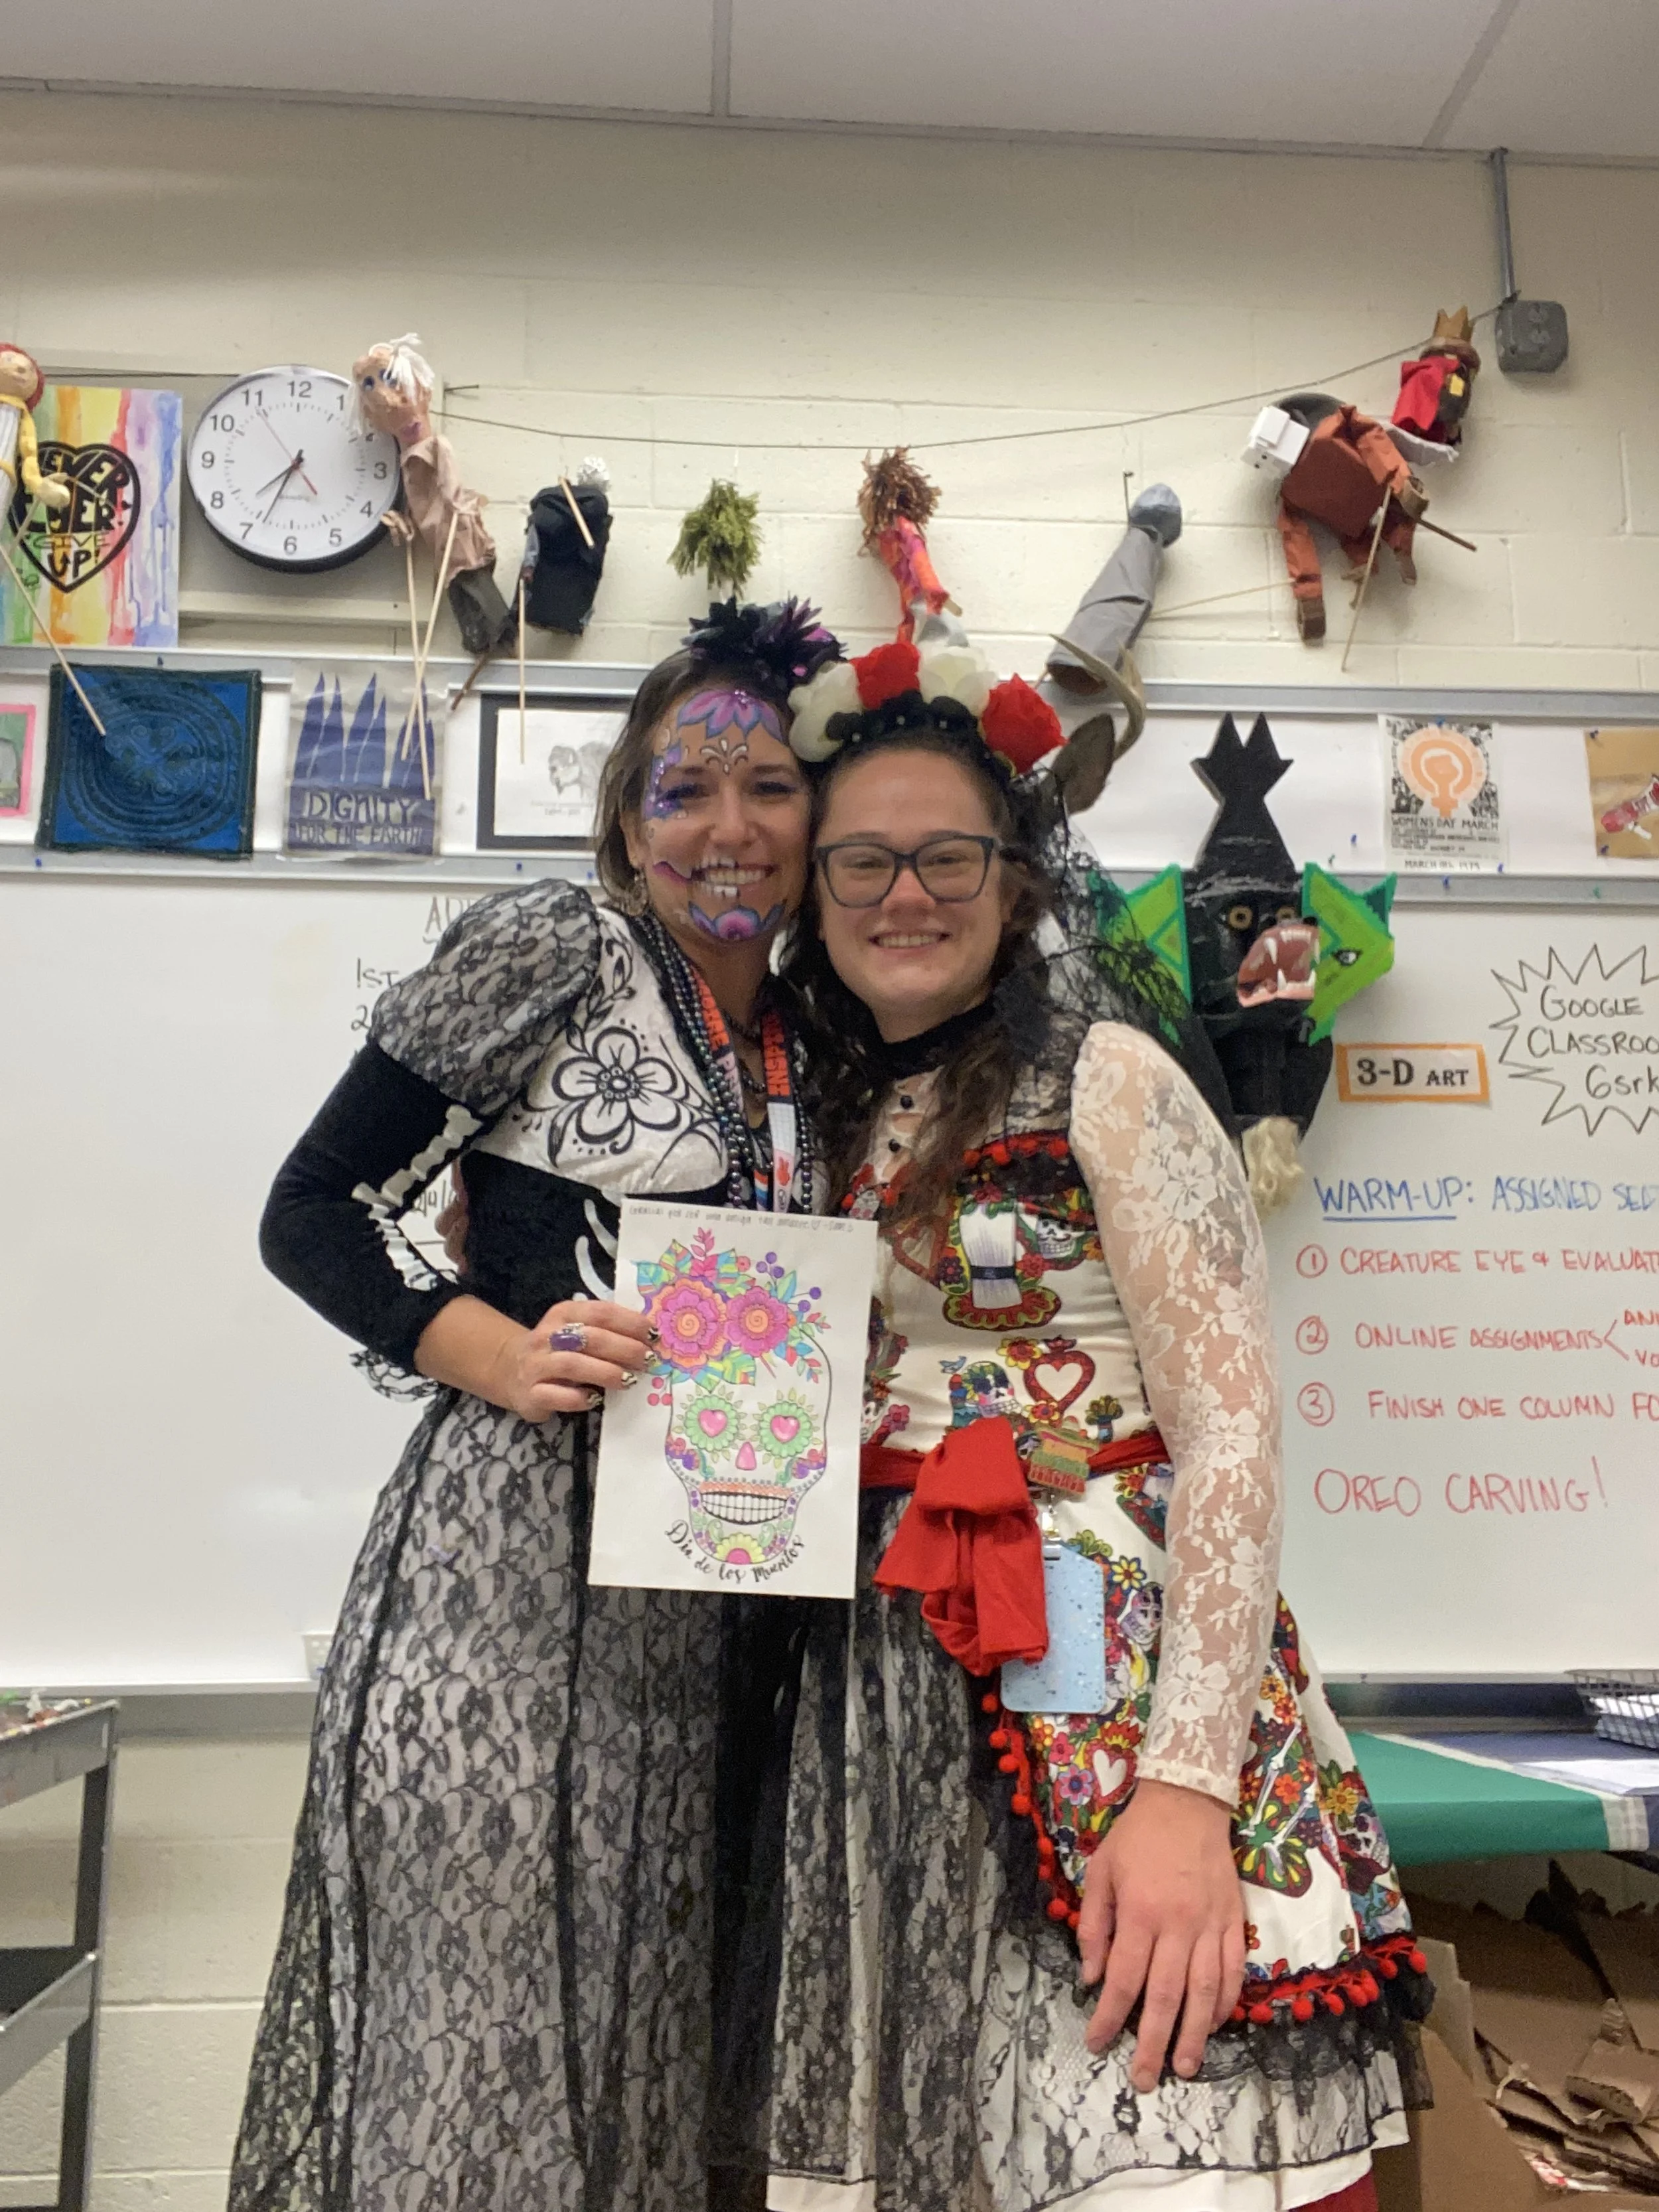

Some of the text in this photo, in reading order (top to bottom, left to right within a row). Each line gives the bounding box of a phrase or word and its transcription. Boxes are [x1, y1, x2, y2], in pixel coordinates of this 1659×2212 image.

[242, 390, 263, 406] 11
[287, 380, 312, 398] 12
[337, 394, 345, 411] 1
[210, 414, 234, 432] 10
[201, 451, 214, 469] 9
[374, 462, 387, 480] 3
[210, 491, 224, 509] 8
[360, 500, 372, 518] 4
[239, 522, 253, 540] 7
[329, 528, 342, 547] 5
[33, 534, 110, 550] GIVE
[283, 536, 297, 554] 6
[47, 548, 100, 579] UP!
[306, 792, 417, 825] DIGNITY
[1462, 819, 1499, 830] MARCH
[333, 824, 363, 845] THE
[1540, 984, 1644, 1021] GOOGLE
[1356, 1058, 1469, 1086] 3-D ART
[1313, 1176, 1473, 1215] WARM-UP:
[1492, 1176, 1601, 1213] ASSIGNED
[1340, 1246, 1461, 1275] CREATURE
[1474, 1249, 1525, 1274] EYE
[1355, 1322, 1459, 1349] ONLINE
[1470, 1327, 1603, 1352] ASSIGNMENTS
[1368, 1390, 1444, 1420] FINISH
[1457, 1396, 1506, 1420] ONE
[1520, 1394, 1614, 1420] COLUMN
[1314, 1455, 1609, 1516] OREO CARVING!
[694, 1556, 713, 1574] de
